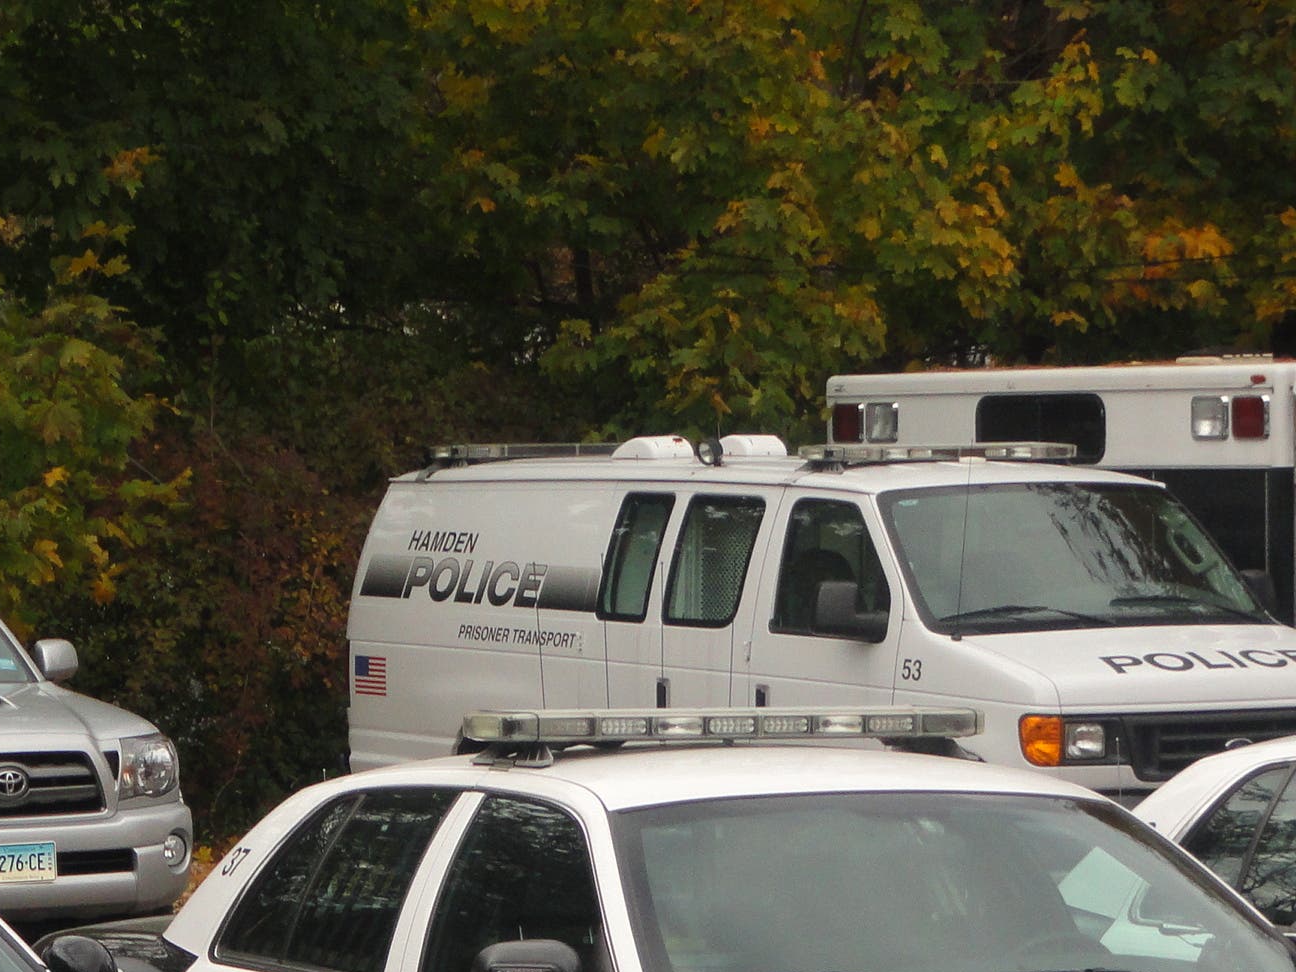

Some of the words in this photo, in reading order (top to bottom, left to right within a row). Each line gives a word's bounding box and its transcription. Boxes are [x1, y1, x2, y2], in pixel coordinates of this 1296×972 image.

[408, 530, 479, 553] HAMDEN
[404, 557, 548, 608] POLICE
[458, 624, 510, 643] PRISONER
[512, 629, 577, 648] TRANSPORT
[902, 659, 922, 681] 53
[222, 847, 251, 877] 37
